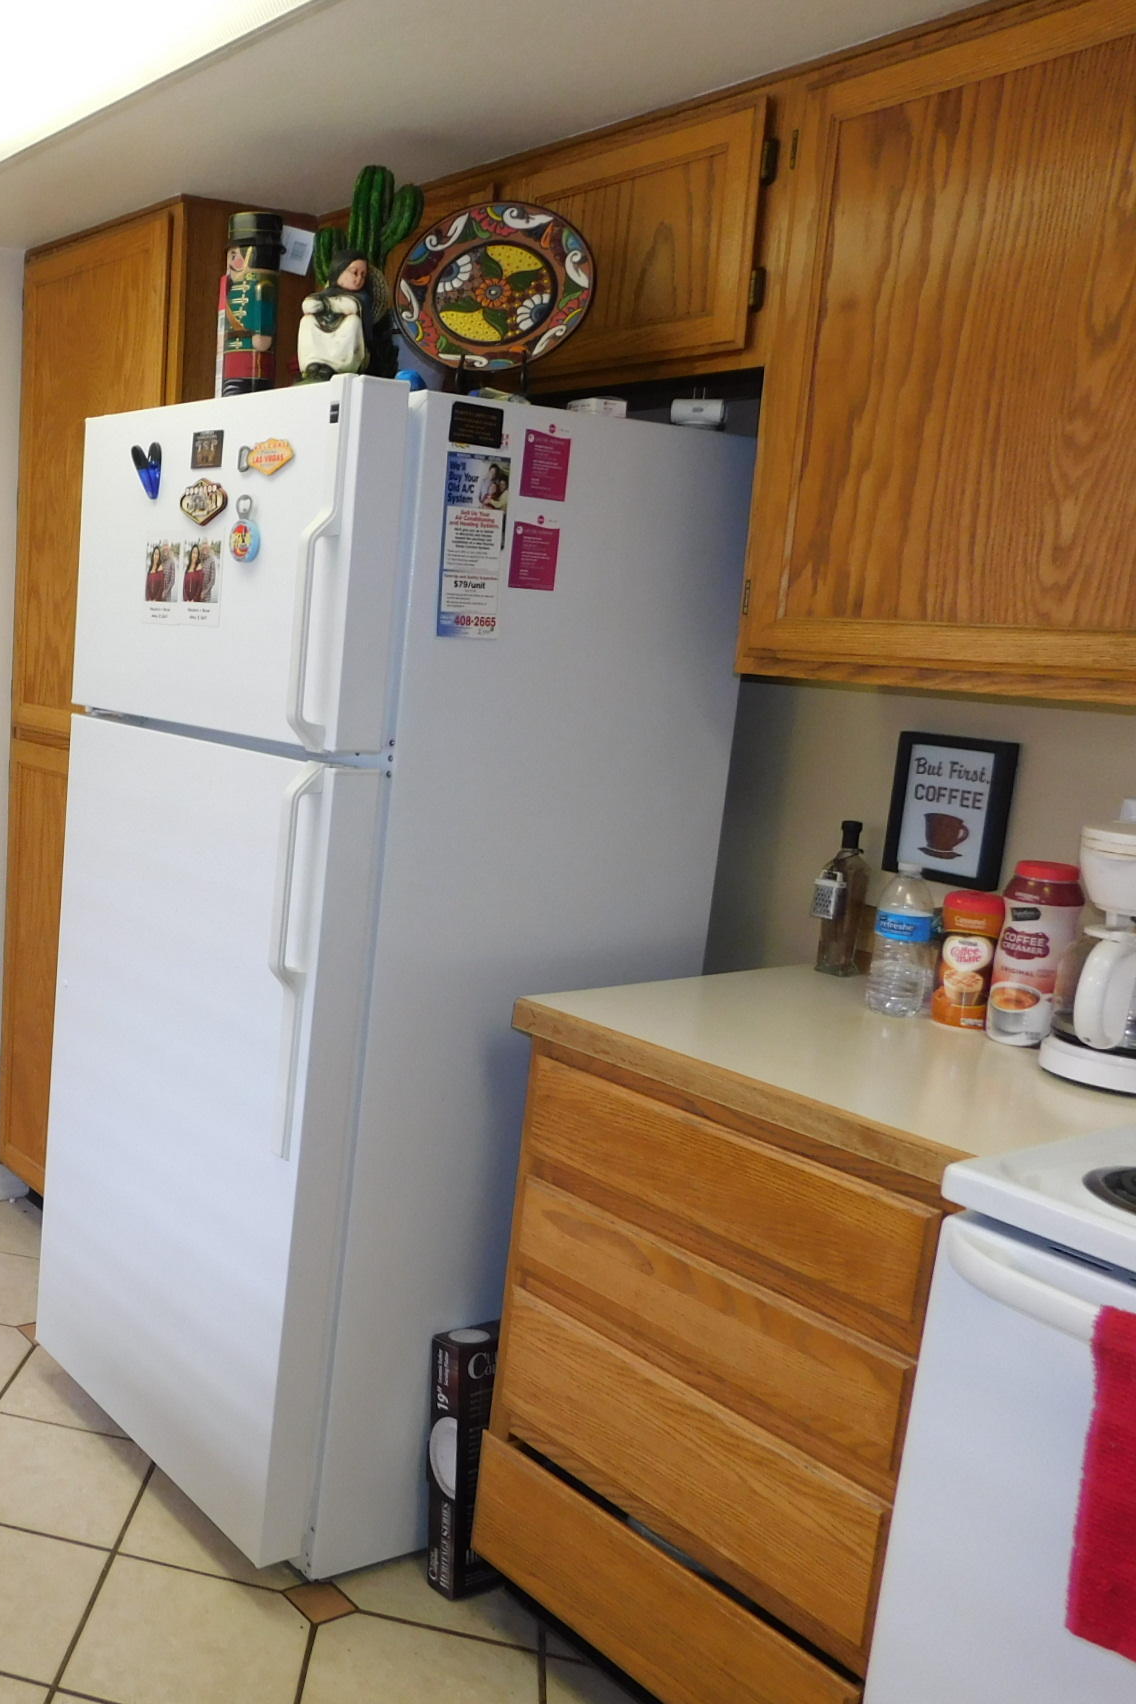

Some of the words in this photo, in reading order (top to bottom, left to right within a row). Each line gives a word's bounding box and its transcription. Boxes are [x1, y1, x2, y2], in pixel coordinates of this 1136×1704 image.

[464, 472, 479, 482] Your
[454, 580, 486, 590] $79/unit
[454, 615, 497, 628] 408-2665
[915, 757, 943, 777] But
[914, 784, 984, 810] COFFEE
[1004, 931, 1046, 947] COFFEE
[1002, 941, 1045, 955] CREAMER
